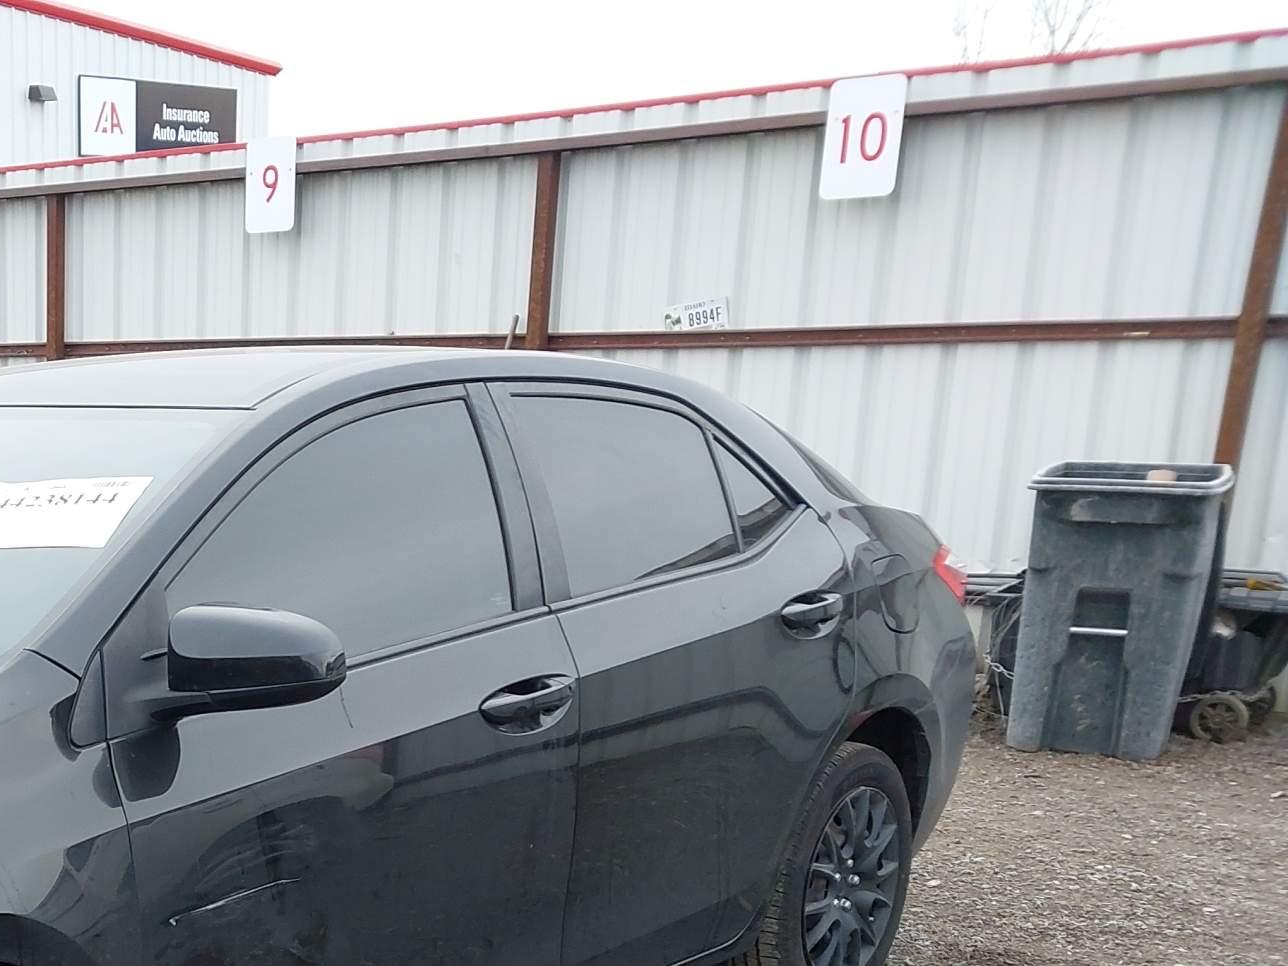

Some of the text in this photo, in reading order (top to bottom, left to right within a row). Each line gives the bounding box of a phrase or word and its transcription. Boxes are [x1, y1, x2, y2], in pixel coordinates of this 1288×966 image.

[162, 103, 210, 123] Insurance
[153, 123, 219, 144] Auto Auctions
[840, 112, 888, 164] 10
[262, 165, 279, 203] 9
